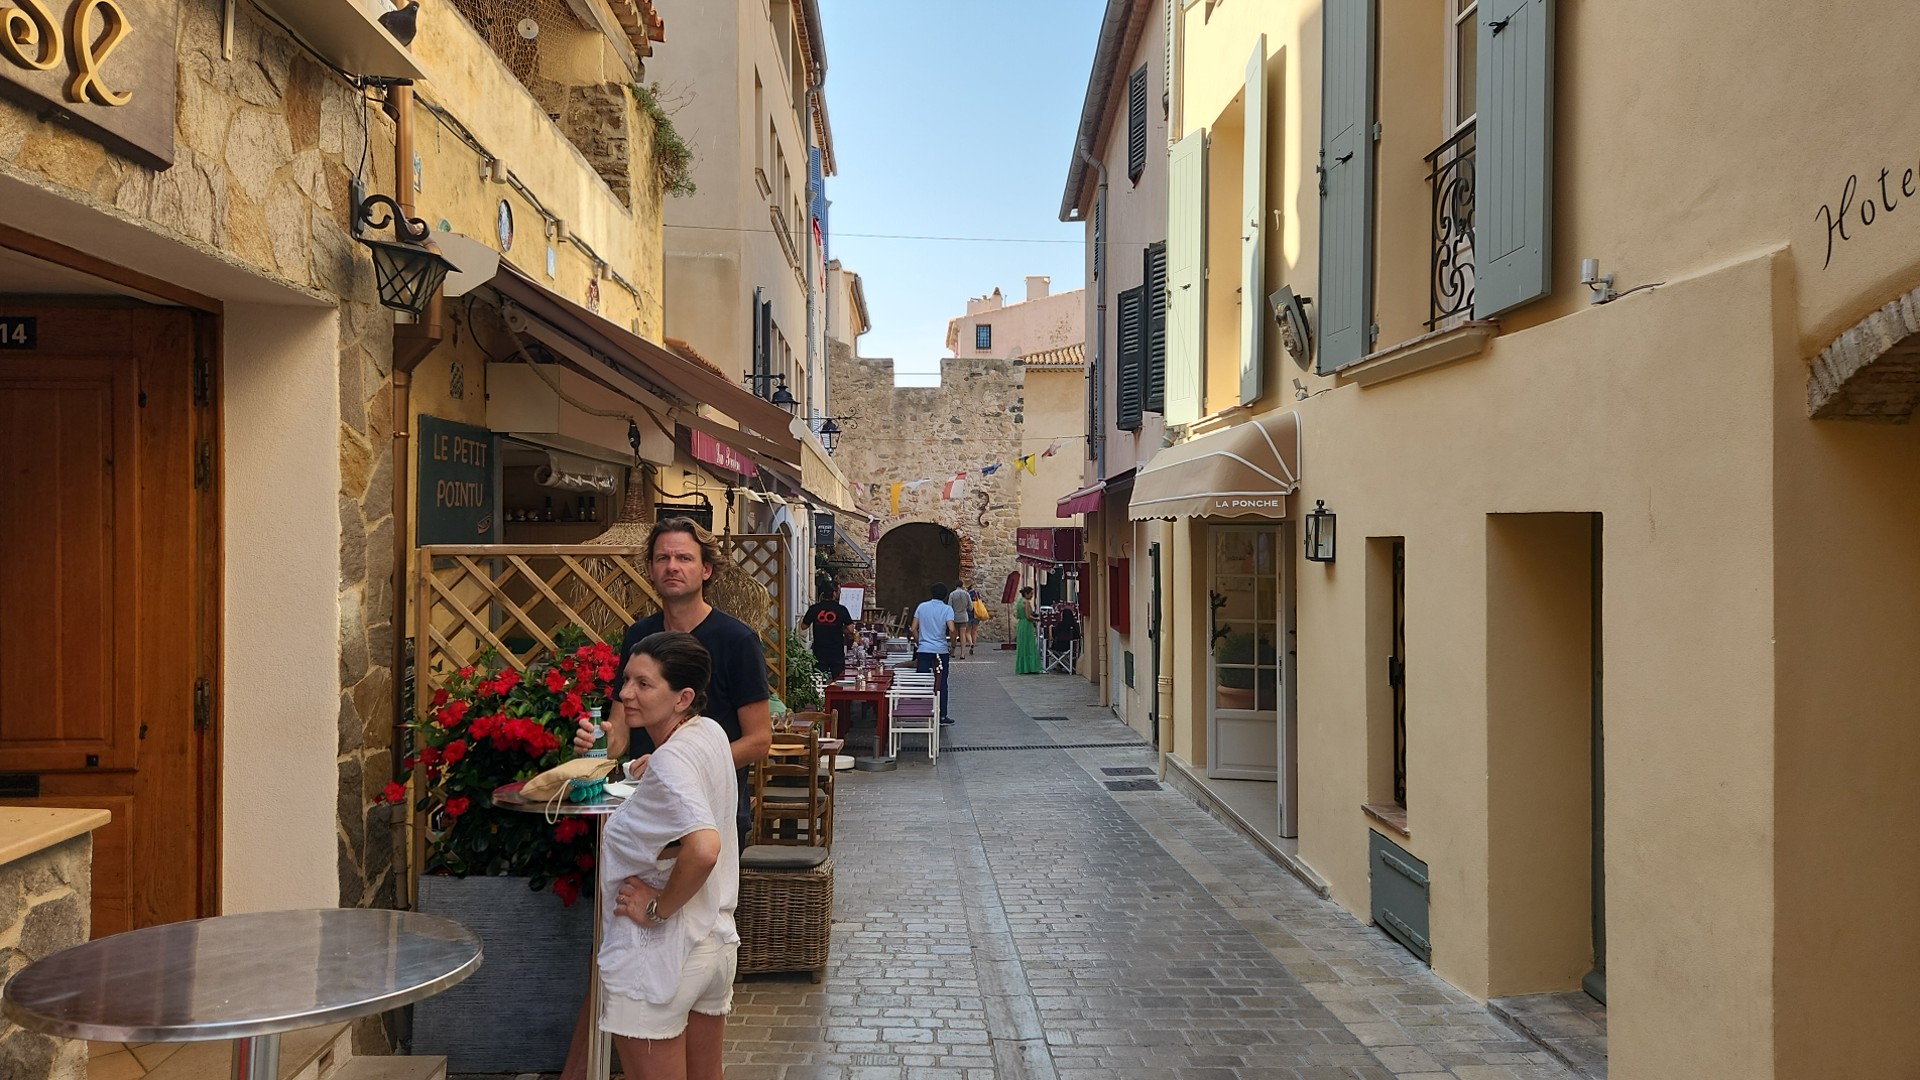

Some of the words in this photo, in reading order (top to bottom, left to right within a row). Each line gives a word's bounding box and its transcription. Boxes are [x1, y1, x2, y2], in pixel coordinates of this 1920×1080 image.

[1815, 160, 1920, 270] Hote
[0, 322, 28, 344] 14
[434, 433, 448, 461] LE
[453, 436, 487, 468] PETIT
[437, 479, 483, 507] POINTU
